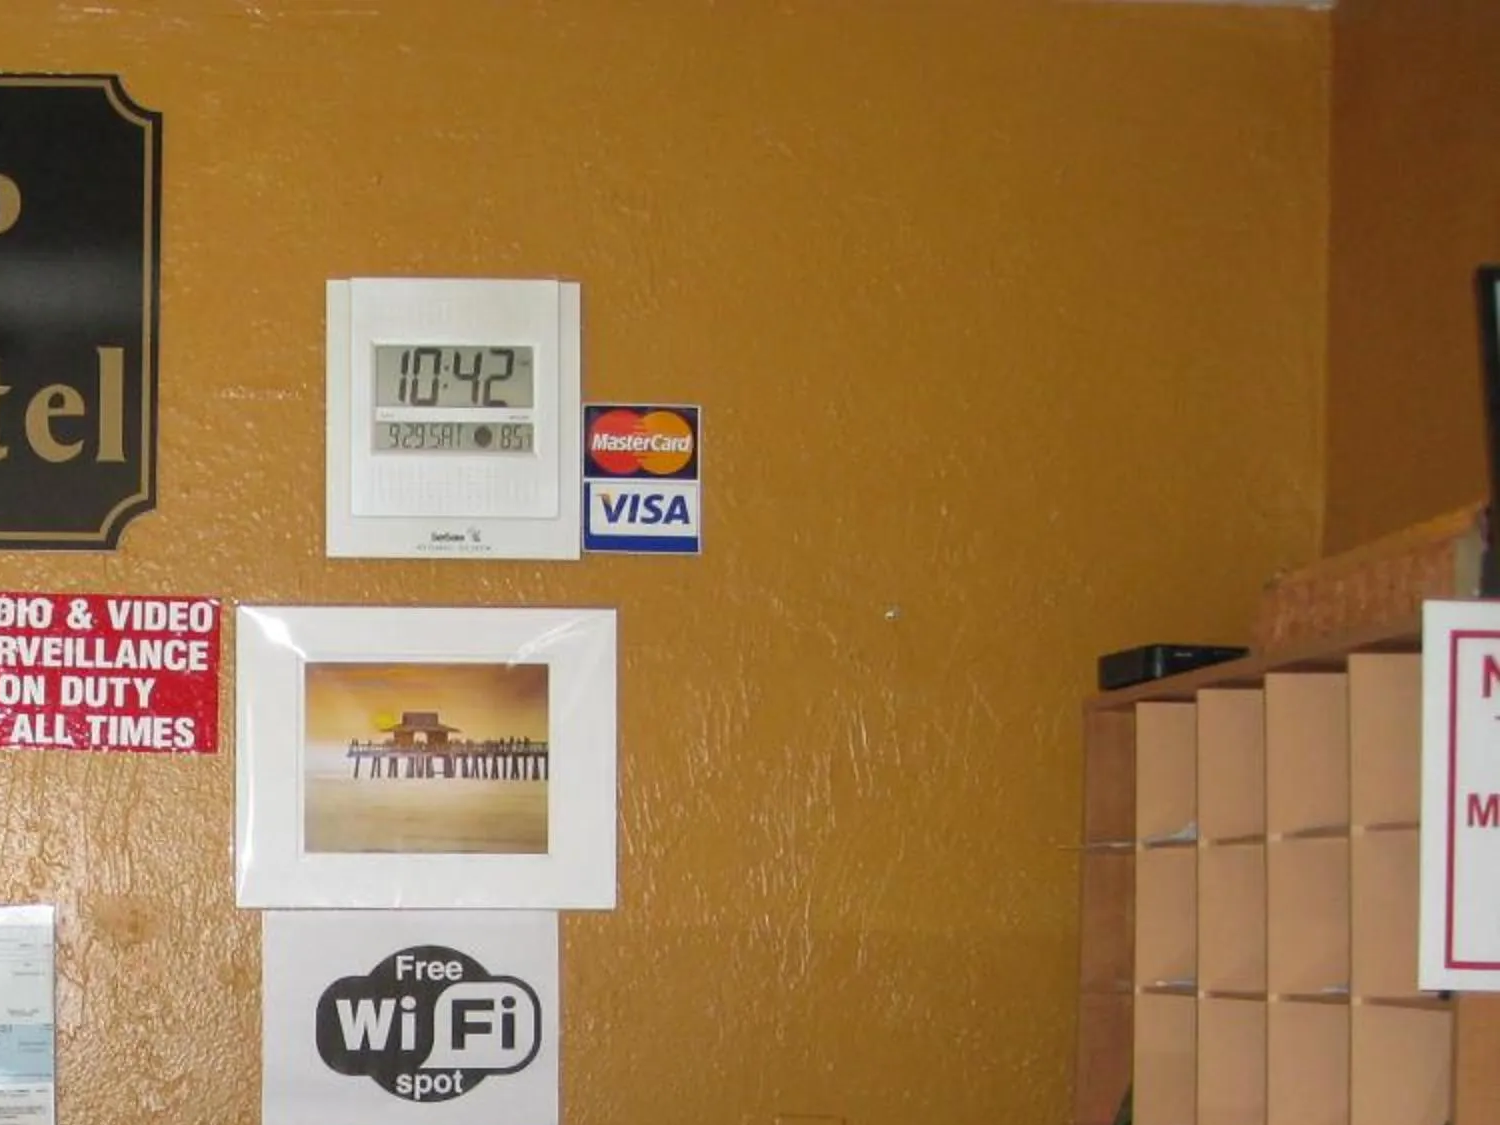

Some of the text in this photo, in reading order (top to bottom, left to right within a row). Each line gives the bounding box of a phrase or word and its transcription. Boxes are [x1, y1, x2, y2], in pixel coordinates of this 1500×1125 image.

[398, 347, 515, 407] 10:42
[591, 433, 692, 453] MasterCard
[598, 493, 691, 525] VISA
[66, 598, 94, 630] &
[107, 600, 214, 633] VIDEO
[60, 675, 156, 708] DUTY
[11, 713, 73, 745] ALL
[86, 715, 196, 749] TIMES
[396, 955, 464, 981] Free
[335, 996, 516, 1051] Wi Fi
[396, 1070, 464, 1099] spot
